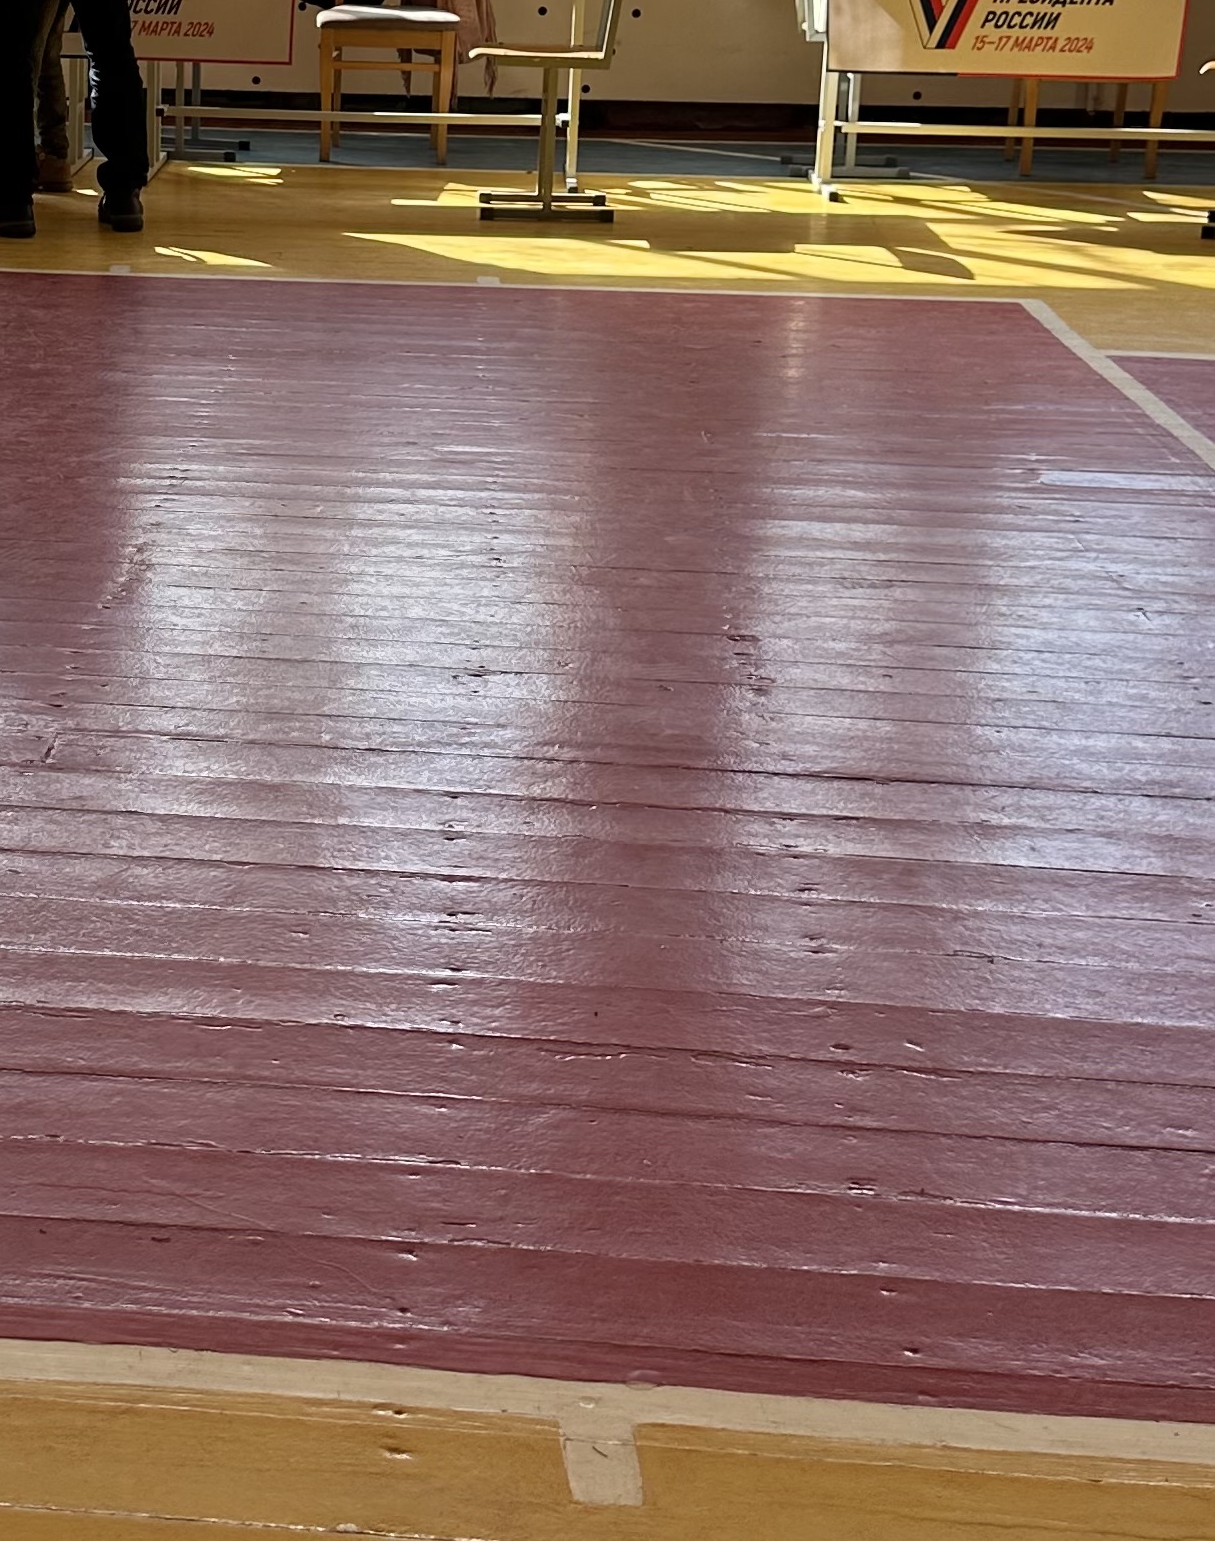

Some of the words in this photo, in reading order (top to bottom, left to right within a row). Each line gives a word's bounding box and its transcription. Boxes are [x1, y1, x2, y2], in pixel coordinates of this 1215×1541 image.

[138, 20, 182, 37] МАРТА
[184, 21, 215, 38] 2024
[980, 10, 1062, 31] РОССИИ
[1011, 36, 1059, 53] МАРТА
[1059, 37, 1095, 54] 2024
